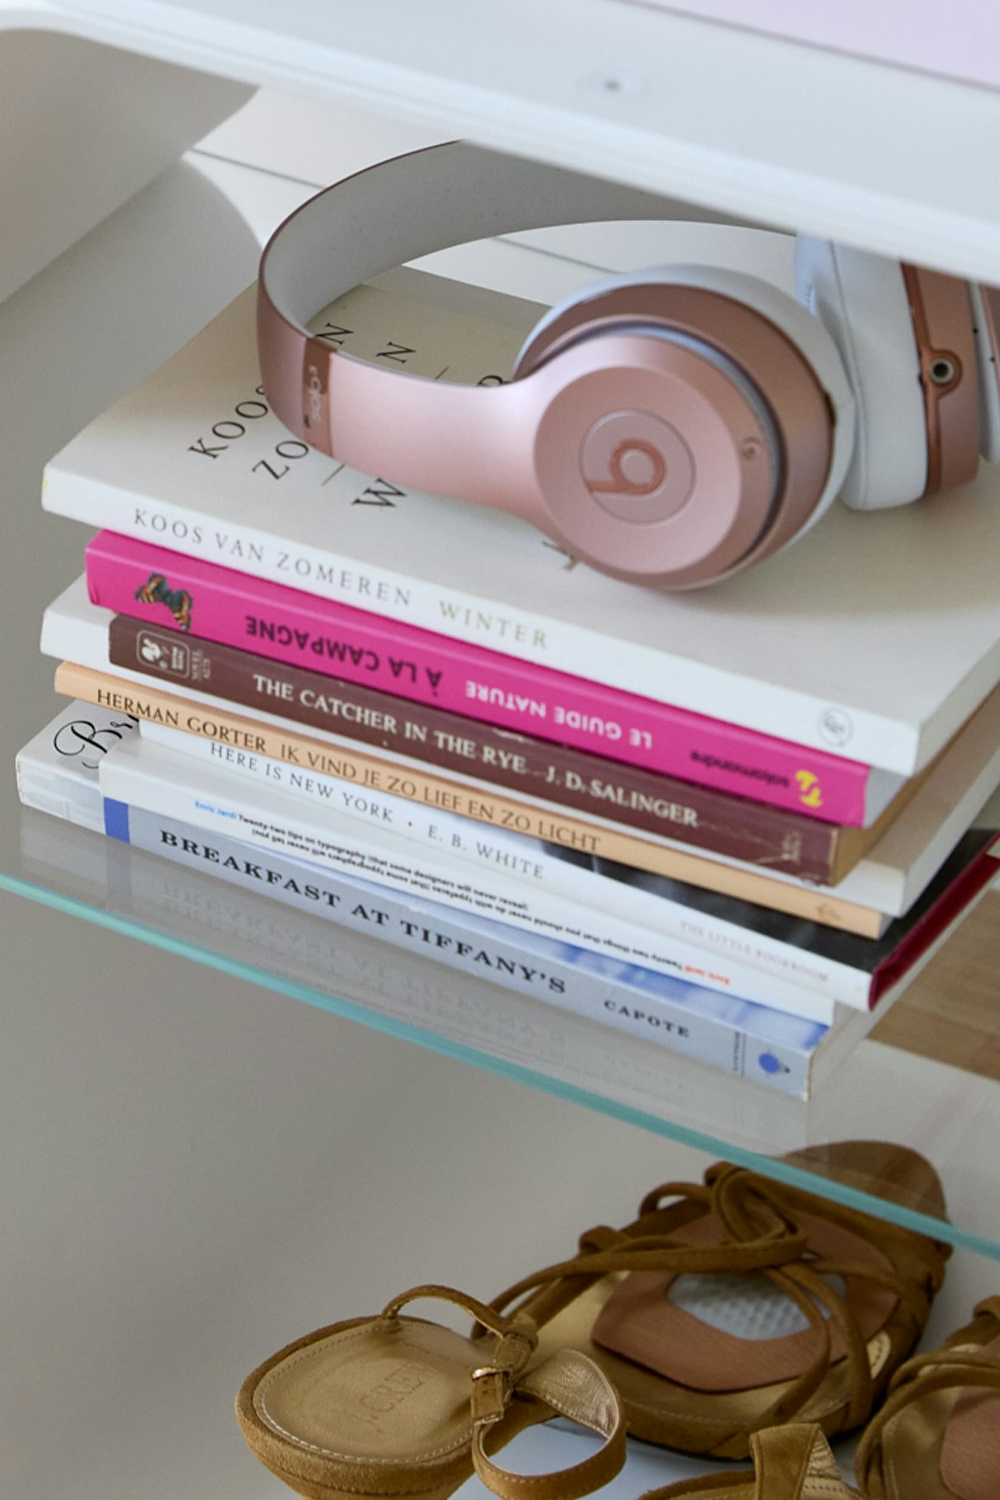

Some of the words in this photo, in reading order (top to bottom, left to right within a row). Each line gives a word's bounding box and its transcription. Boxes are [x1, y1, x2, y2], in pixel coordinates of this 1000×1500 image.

[133, 507, 203, 544] KOOS
[214, 532, 264, 563] VAN
[276, 551, 412, 607] ZOMEREN
[439, 600, 549, 649] WINTER
[244, 614, 381, 672] CAMPAGNE
[387, 655, 418, 684] LA
[465, 679, 548, 718] NATURE
[553, 705, 623, 741] GUIDE
[629, 727, 653, 750] LE
[96, 688, 180, 726] HERMAN
[186, 716, 267, 753] GORTER
[280, 743, 300, 764] IK
[306, 751, 357, 779] VIND
[362, 768, 382, 787] JE
[387, 775, 417, 797] ZO
[423, 785, 462, 811] LIEF
[467, 799, 495, 821] EN
[501, 809, 531, 832] ZO
[538, 820, 602, 852] LICHT
[252, 673, 295, 702] THE
[299, 689, 398, 735] CATCHER
[404, 720, 428, 743] IN
[433, 730, 477, 759] THE
[482, 745, 527, 774] RYE
[589, 779, 700, 829] SALINGER
[210, 742, 258, 772] HERE
[265, 762, 283, 781] IS
[289, 772, 335, 800] NEW
[342, 791, 394, 824] YORK
[475, 841, 545, 880] WHITE
[159, 828, 342, 908] BREAKFAST
[351, 903, 390, 927] AT
[399, 919, 567, 995] TIFFANY'S
[603, 999, 691, 1039] CAPOTE
